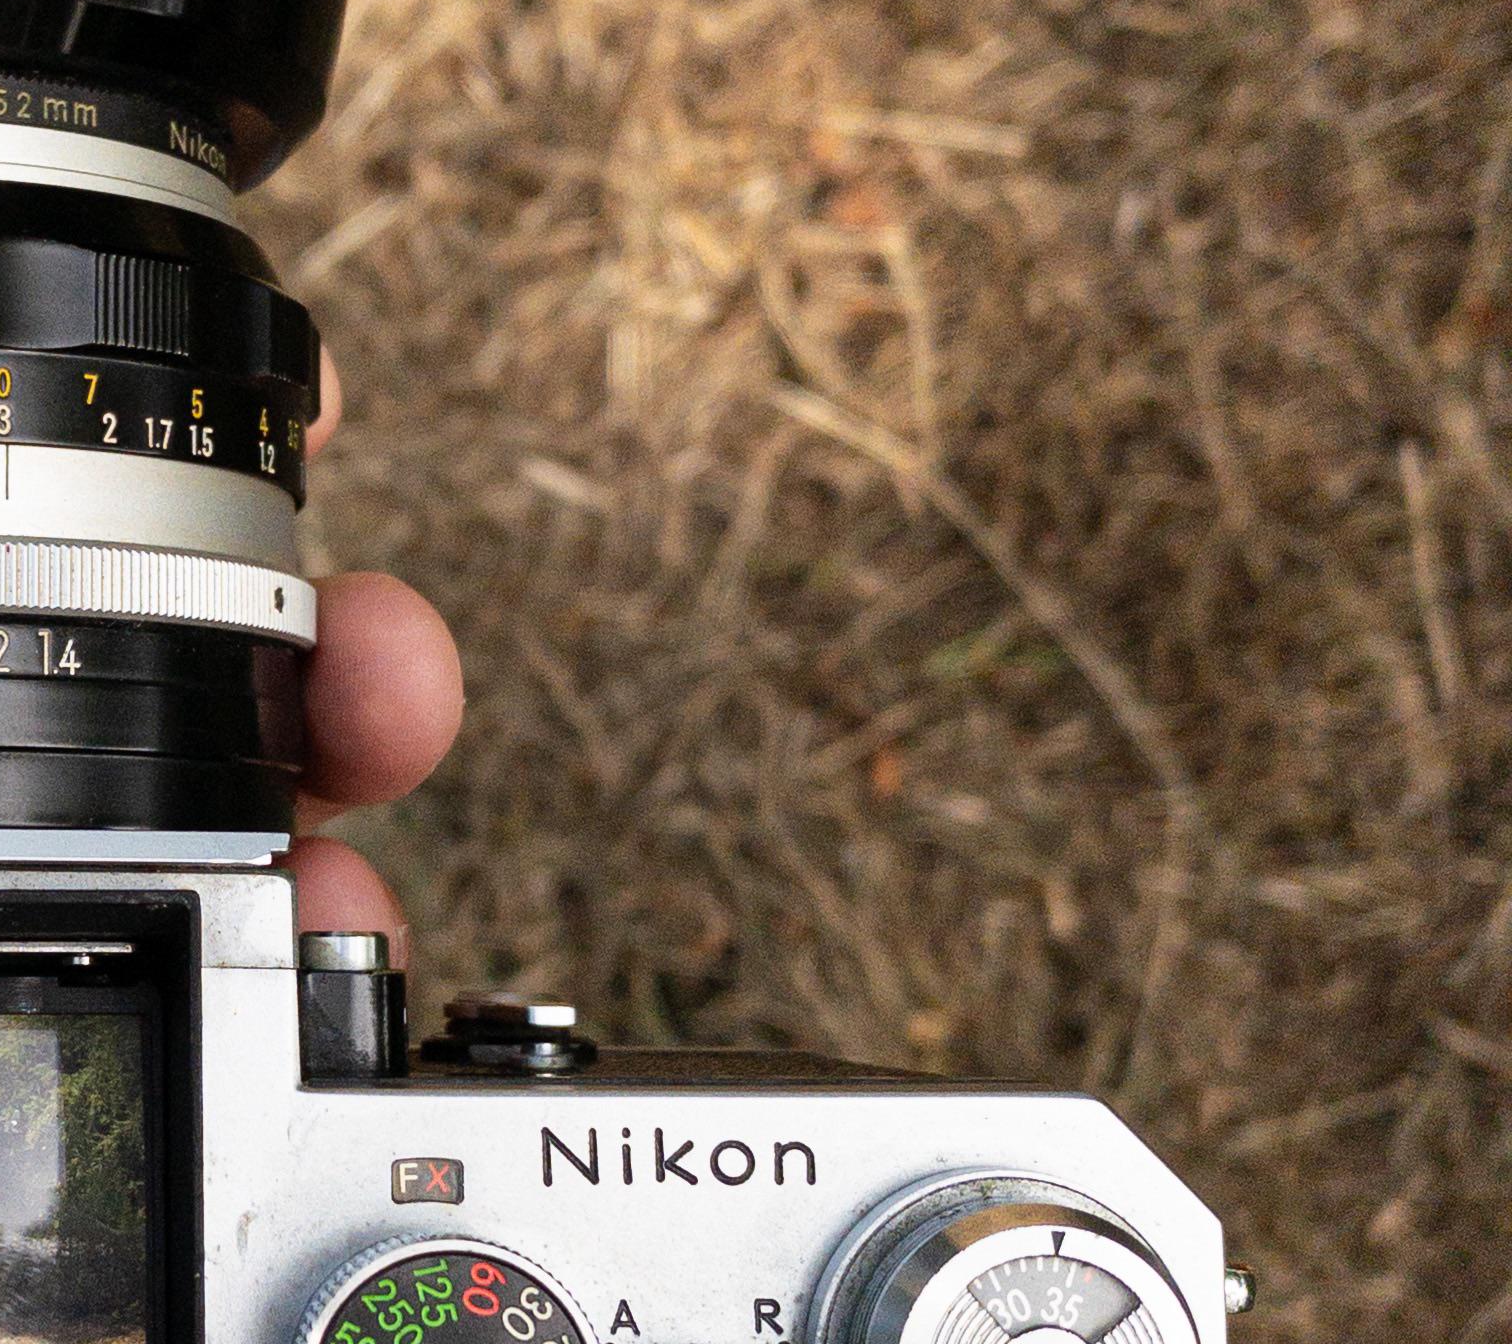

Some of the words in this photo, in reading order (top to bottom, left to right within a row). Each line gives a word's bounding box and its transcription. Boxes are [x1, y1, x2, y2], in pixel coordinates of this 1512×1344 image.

[83, 373, 100, 405] 7
[191, 388, 204, 420] 5
[259, 408, 269, 437] 4
[101, 412, 118, 444] 2
[37, 629, 82, 677] 1.4
[541, 1127, 817, 1187] Nikon
[413, 1259, 459, 1328] 125
[461, 1260, 508, 1318] 60
[500, 1286, 554, 1342] 30
[987, 1287, 1032, 1329] 30
[1039, 1286, 1085, 1328] 35
[610, 1299, 641, 1337] A
[754, 1297, 784, 1335] R
